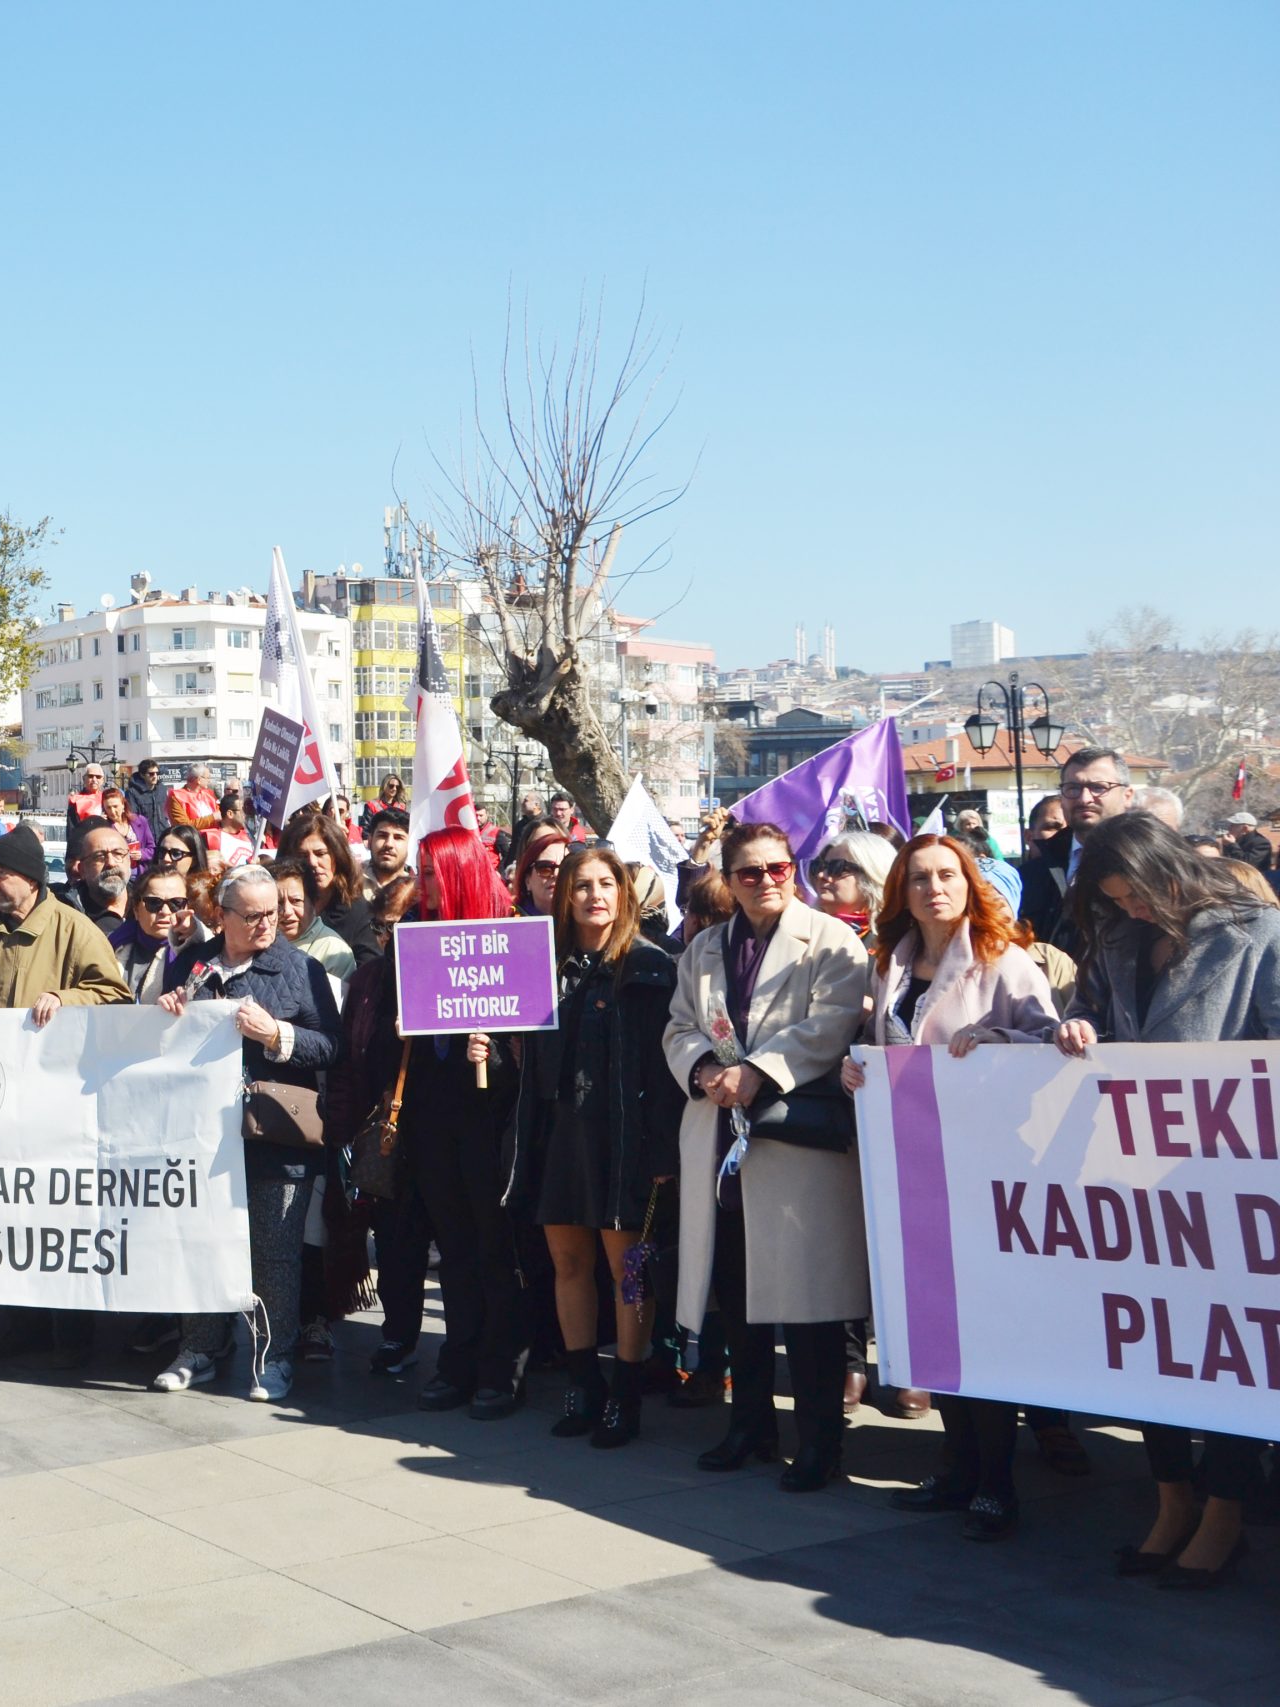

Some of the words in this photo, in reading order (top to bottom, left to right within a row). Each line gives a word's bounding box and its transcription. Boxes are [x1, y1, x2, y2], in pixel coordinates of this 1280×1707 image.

[440, 931, 476, 961] EŞİT
[481, 929, 509, 955] BİR
[448, 965, 505, 992] YAŞAM
[436, 993, 520, 1019] İSTİYORUZ
[1097, 1058, 1279, 1160] TEKİ
[49, 1158, 198, 1208] DERNEĞİ
[991, 1180, 1215, 1270] KADIN
[1102, 1292, 1280, 1391] PLAT
